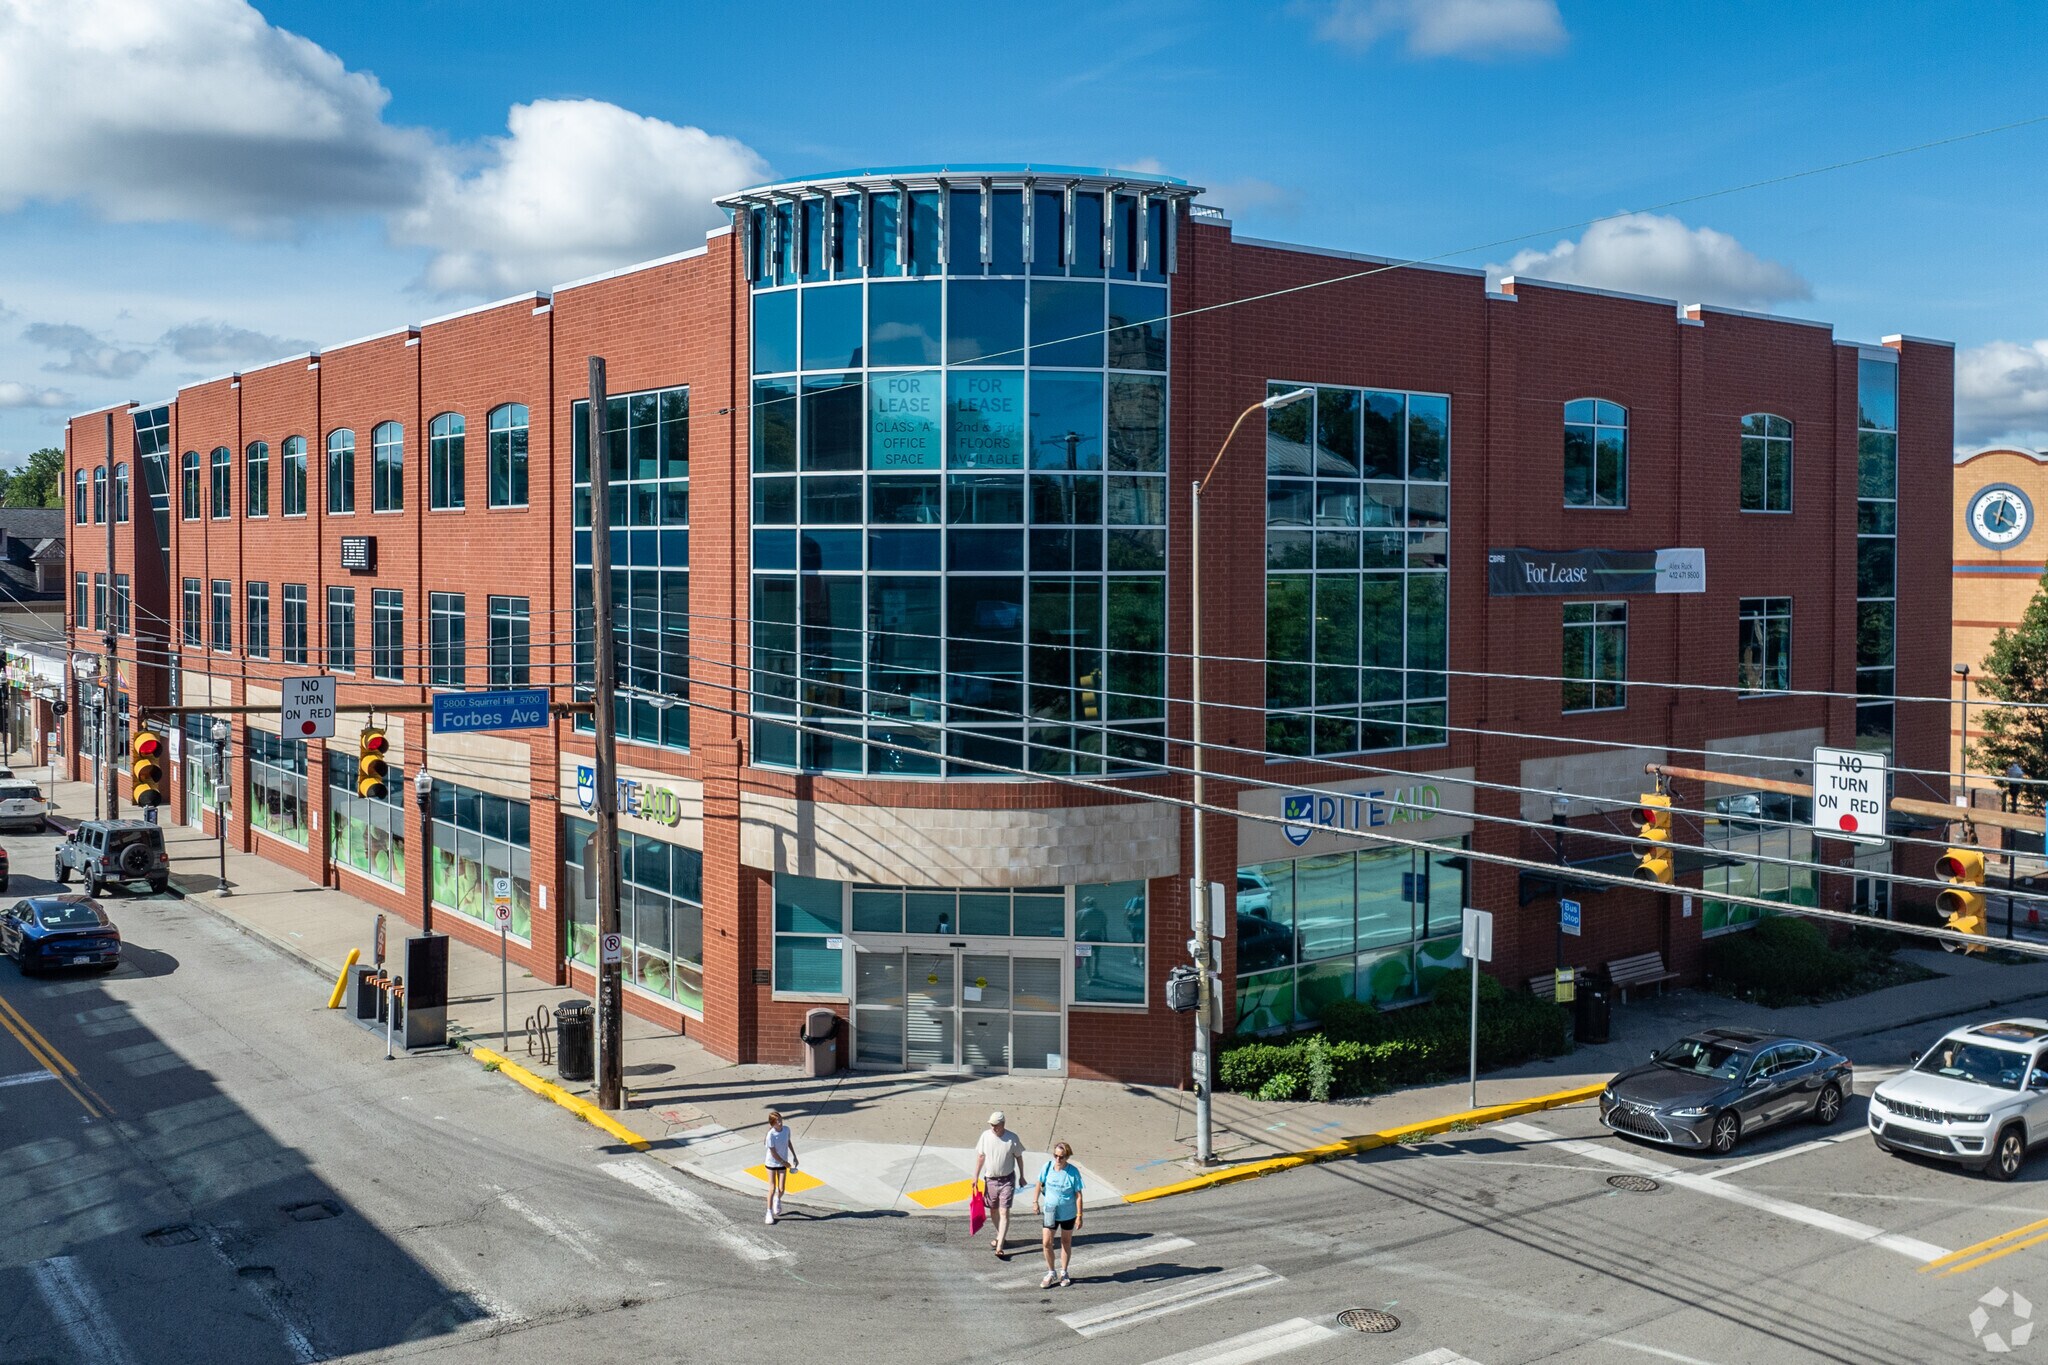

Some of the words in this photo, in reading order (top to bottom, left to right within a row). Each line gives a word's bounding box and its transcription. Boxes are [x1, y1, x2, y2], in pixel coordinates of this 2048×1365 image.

[889, 379, 920, 393] FOR
[968, 378, 1002, 393] FOR
[879, 398, 930, 413] LEASE
[958, 398, 1012, 412] LEASE
[875, 421, 915, 433] CLASS
[956, 421, 978, 433] 2nd
[982, 422, 992, 433] &
[995, 421, 1015, 433] 3rd
[883, 437, 926, 448] OFFICE
[960, 437, 1010, 448] FLOORS
[885, 454, 924, 465] SPACE
[952, 453, 1020, 465] AVAILABLE
[1525, 562, 1547, 584] For
[1549, 562, 1588, 583] Lease
[301, 680, 319, 691] NO
[294, 694, 324, 705] TURN
[443, 699, 466, 708] 5800
[469, 698, 500, 707] Squirrel
[503, 697, 515, 705] Hill
[520, 696, 540, 704] 5700
[285, 710, 300, 720] ON
[310, 708, 332, 719] RED
[442, 711, 502, 728] Forbes
[510, 708, 540, 724] Ave
[1839, 755, 1862, 773] NO
[1830, 775, 1868, 793] TURN
[1317, 790, 1386, 829] RITE
[1388, 784, 1441, 825] AID
[1819, 794, 1838, 809] ON
[1850, 798, 1879, 815] RED
[1565, 903, 1577, 913] Bus
[1564, 912, 1578, 924] Stop
